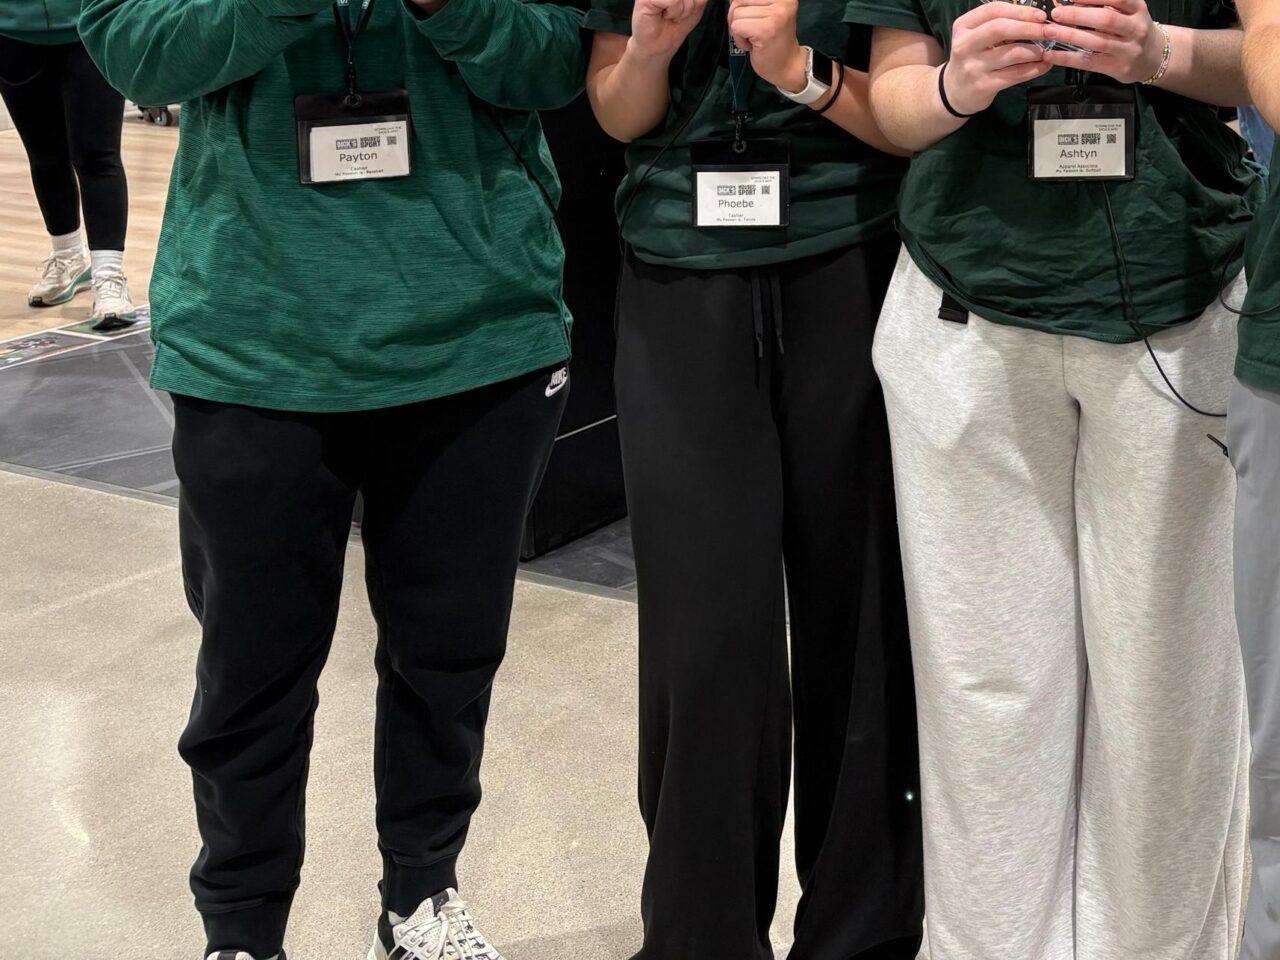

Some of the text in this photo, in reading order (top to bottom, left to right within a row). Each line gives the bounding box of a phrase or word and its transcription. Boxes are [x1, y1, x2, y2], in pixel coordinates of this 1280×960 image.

[340, 152, 377, 163] Payton
[1060, 149, 1098, 159] Ashtyn
[718, 200, 754, 208] Phoebe
